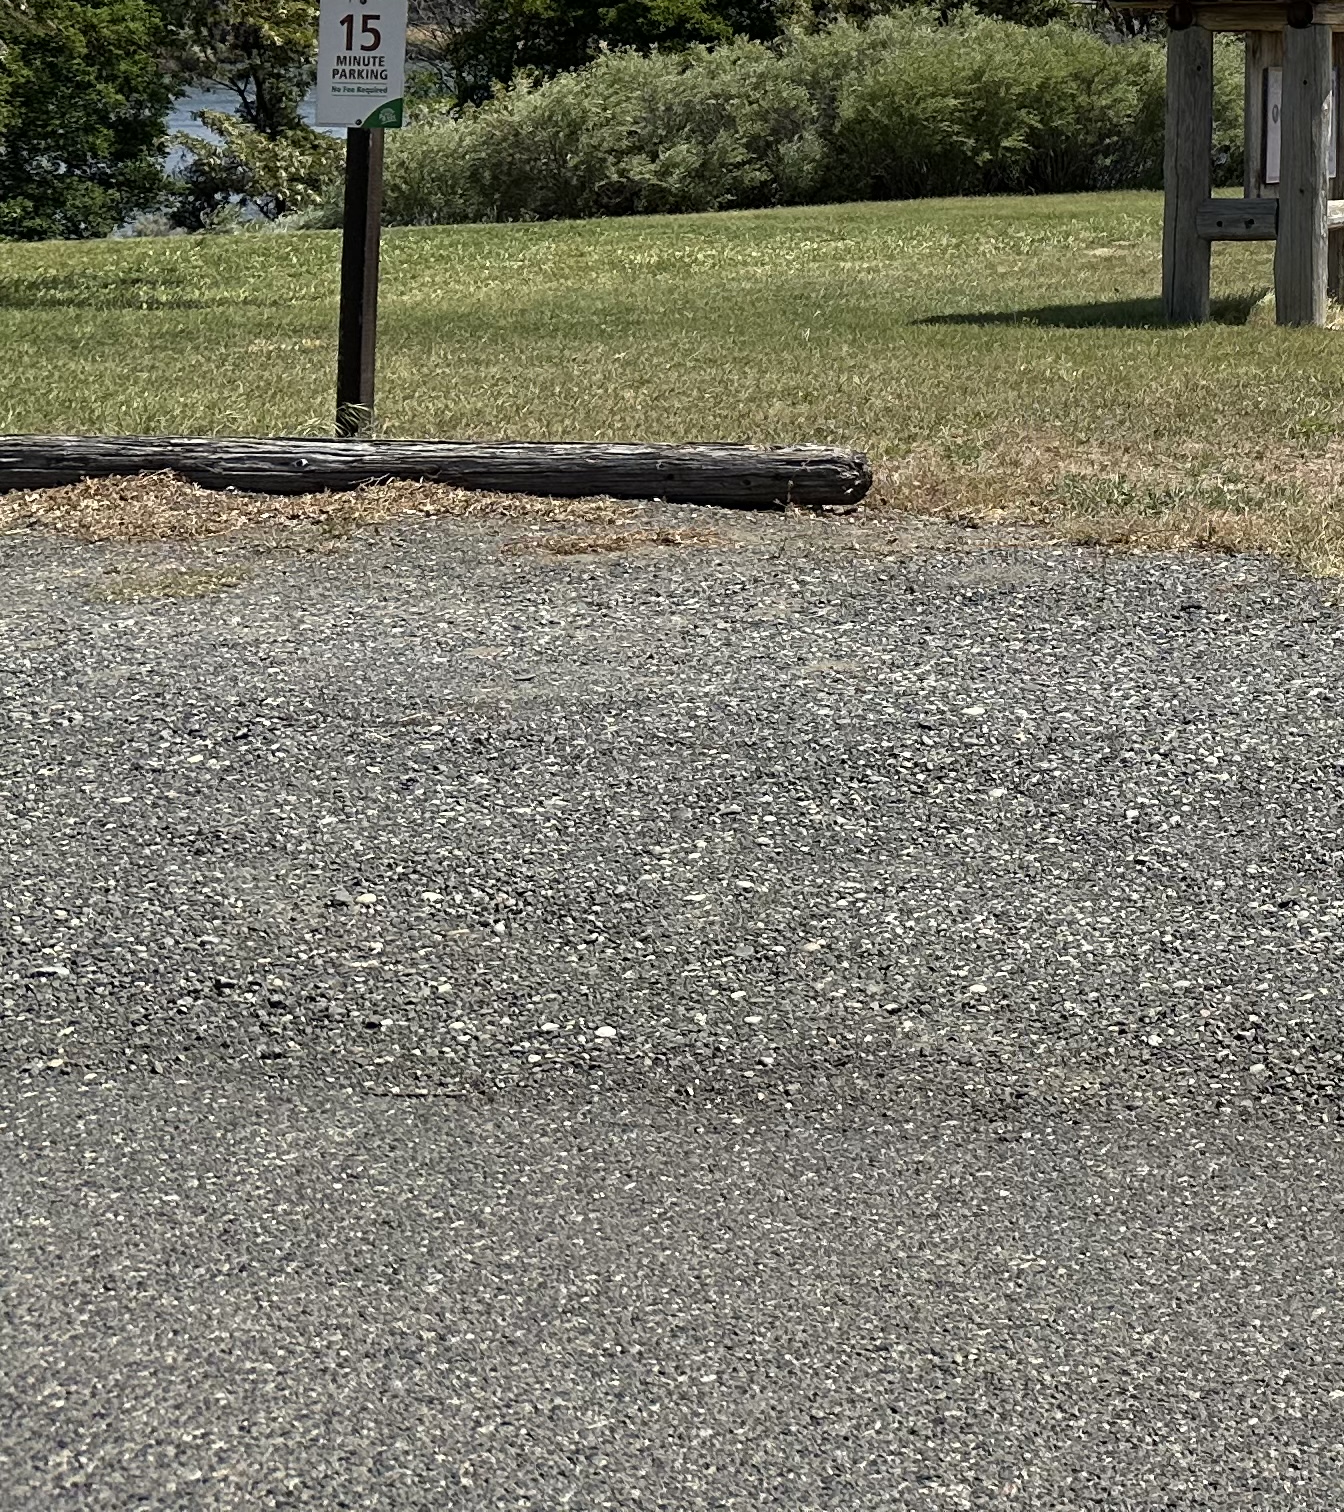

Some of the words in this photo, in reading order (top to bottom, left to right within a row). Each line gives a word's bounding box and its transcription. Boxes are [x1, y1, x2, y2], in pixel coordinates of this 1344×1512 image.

[340, 14, 382, 52] 15
[337, 56, 386, 67] MINUTE
[332, 69, 388, 81] PARKING
[357, 86, 388, 95] Required
